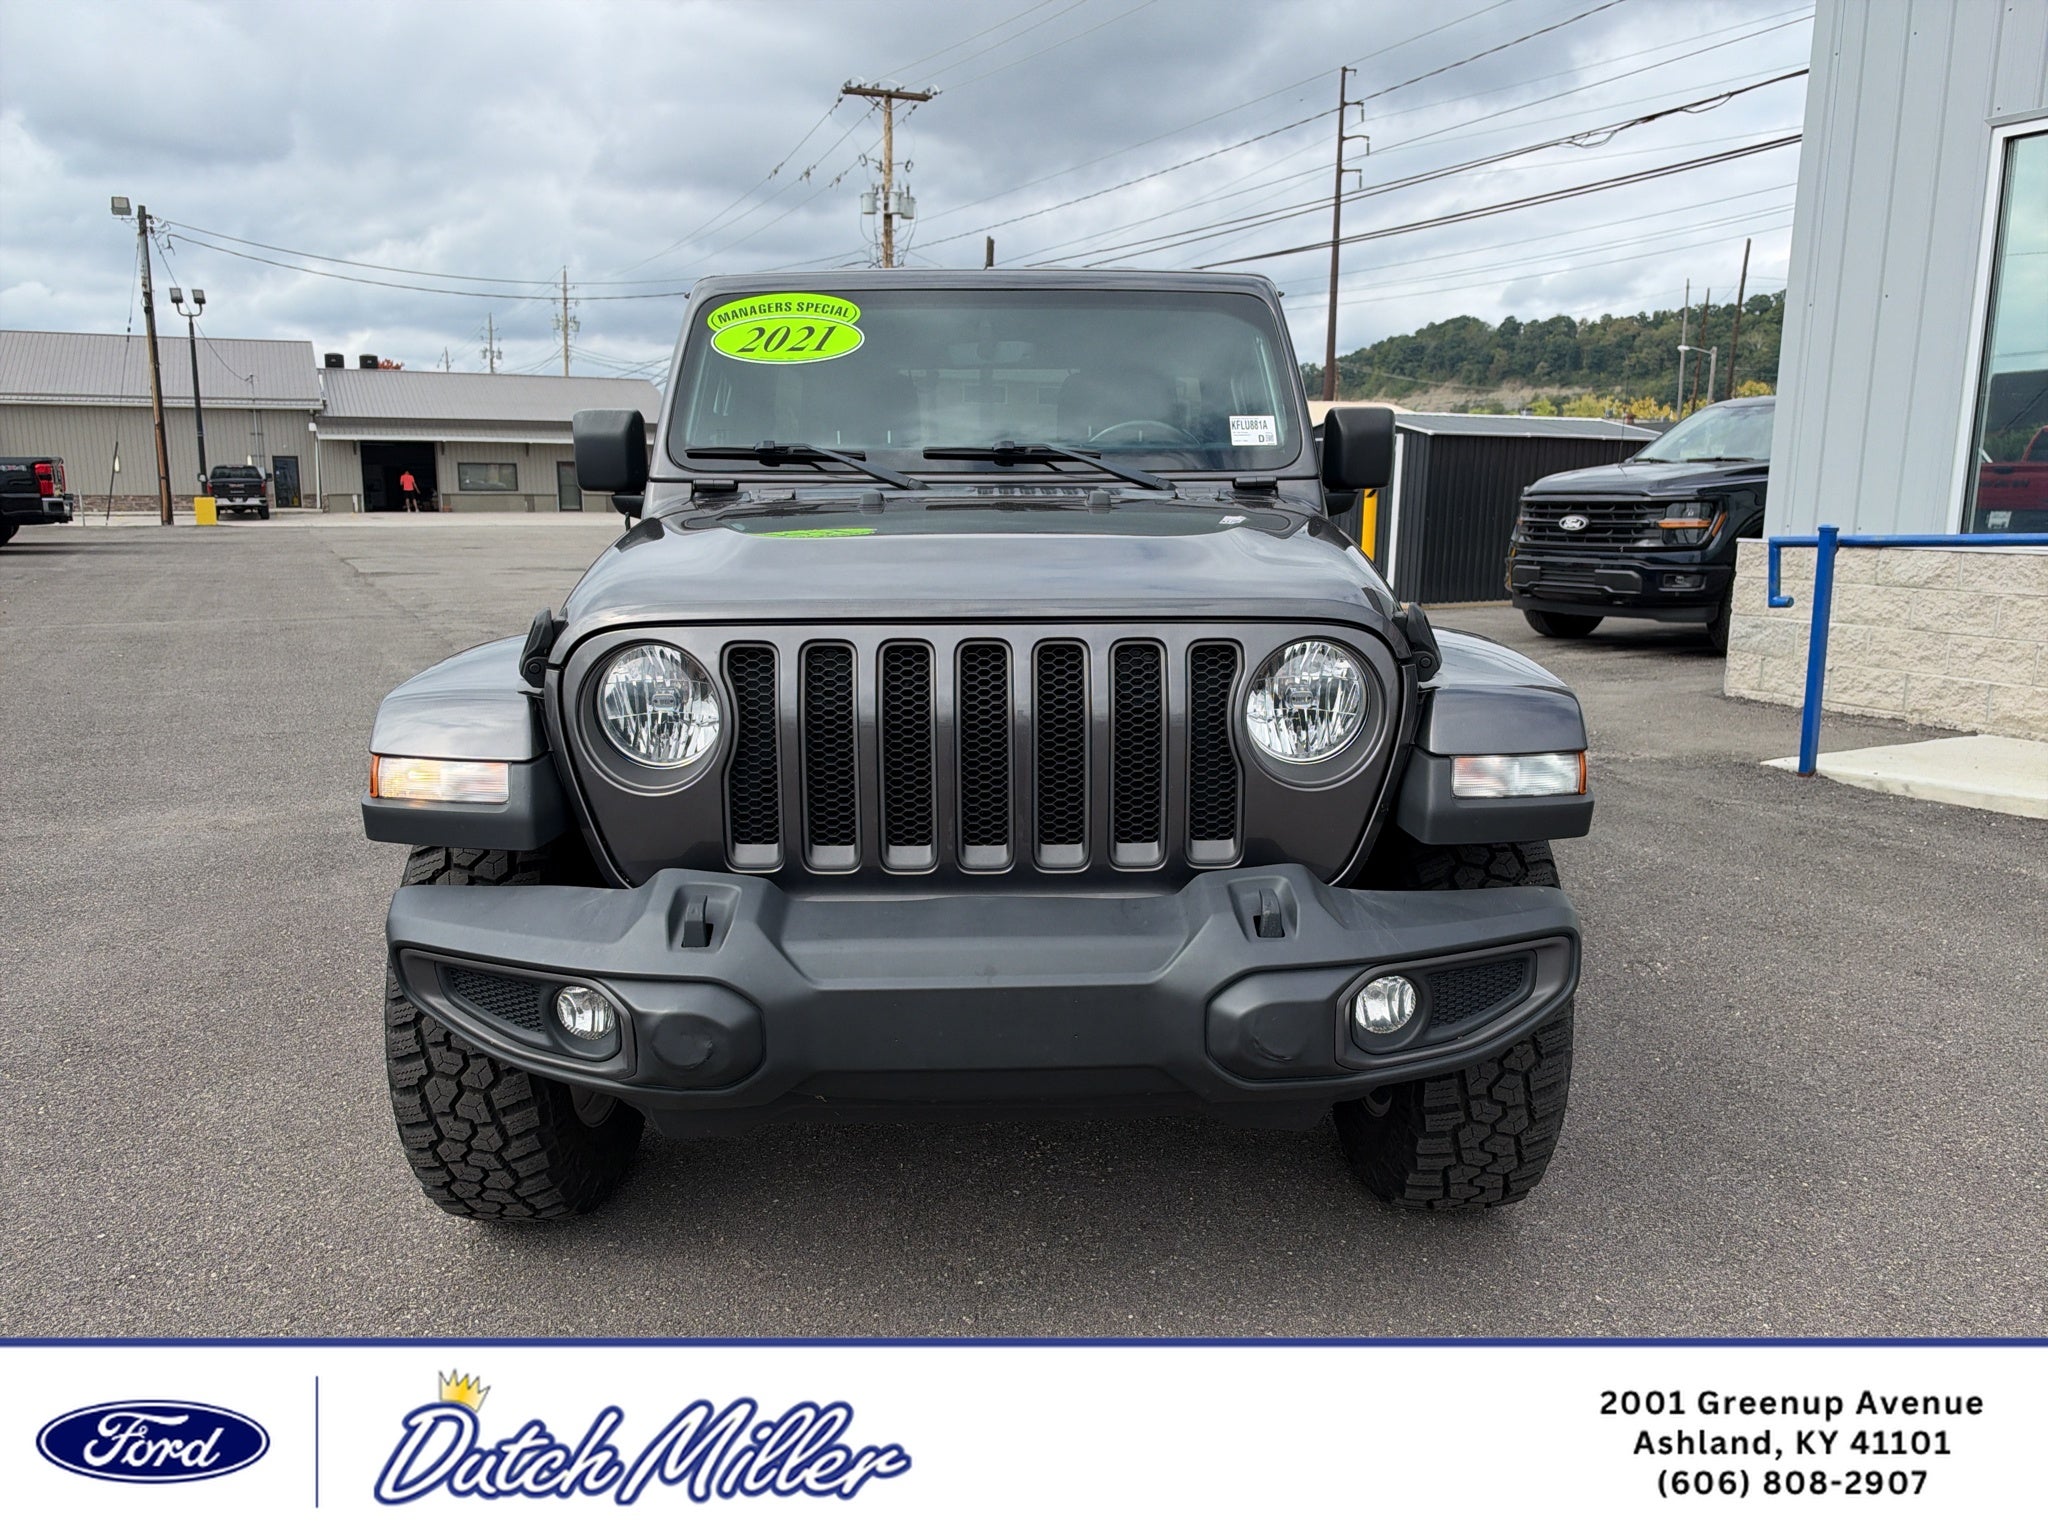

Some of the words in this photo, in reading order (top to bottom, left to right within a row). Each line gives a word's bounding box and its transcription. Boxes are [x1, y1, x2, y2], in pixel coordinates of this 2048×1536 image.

[716, 301, 792, 324] MANAGERS
[796, 301, 850, 318] SPECIAL
[736, 325, 838, 353] 2021
[1232, 419, 1268, 430] KFLU881A
[1258, 434, 1265, 443] D
